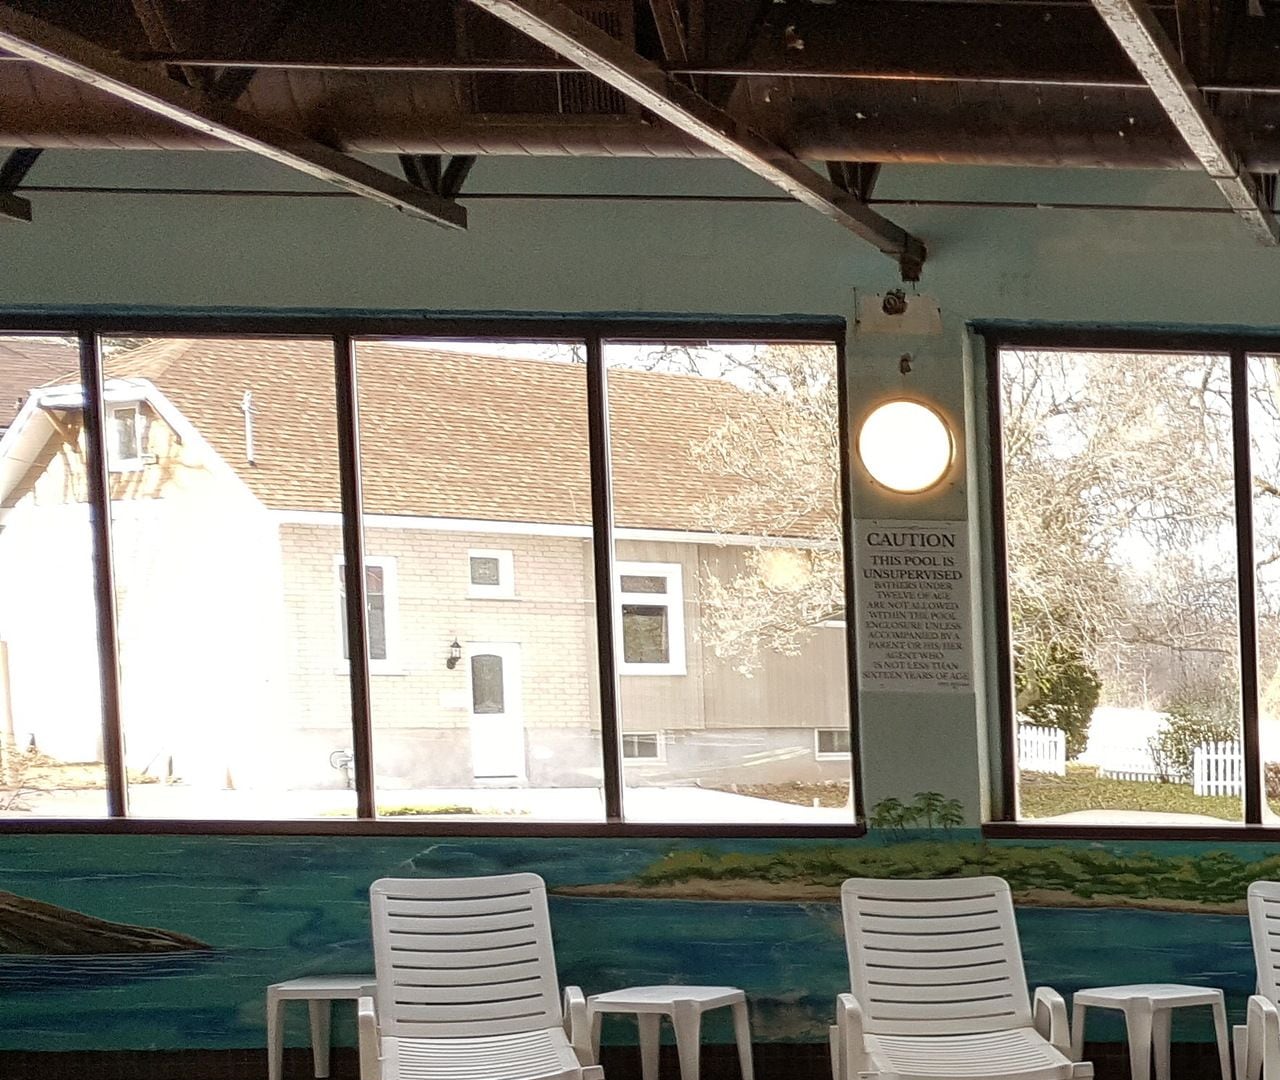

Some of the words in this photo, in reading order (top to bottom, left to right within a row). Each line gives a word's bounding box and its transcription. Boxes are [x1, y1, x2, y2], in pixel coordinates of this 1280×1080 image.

[867, 532, 956, 548] CAUTION
[870, 555, 901, 566] THIS
[904, 556, 940, 566] POOL
[943, 556, 955, 566] IS
[863, 568, 963, 580] UNSUPERVISED
[874, 581, 917, 590] BATHERS
[919, 582, 953, 590] UNDER
[866, 601, 886, 609] ARE
[888, 601, 909, 609] NOT
[910, 602, 960, 610] ALLOWED
